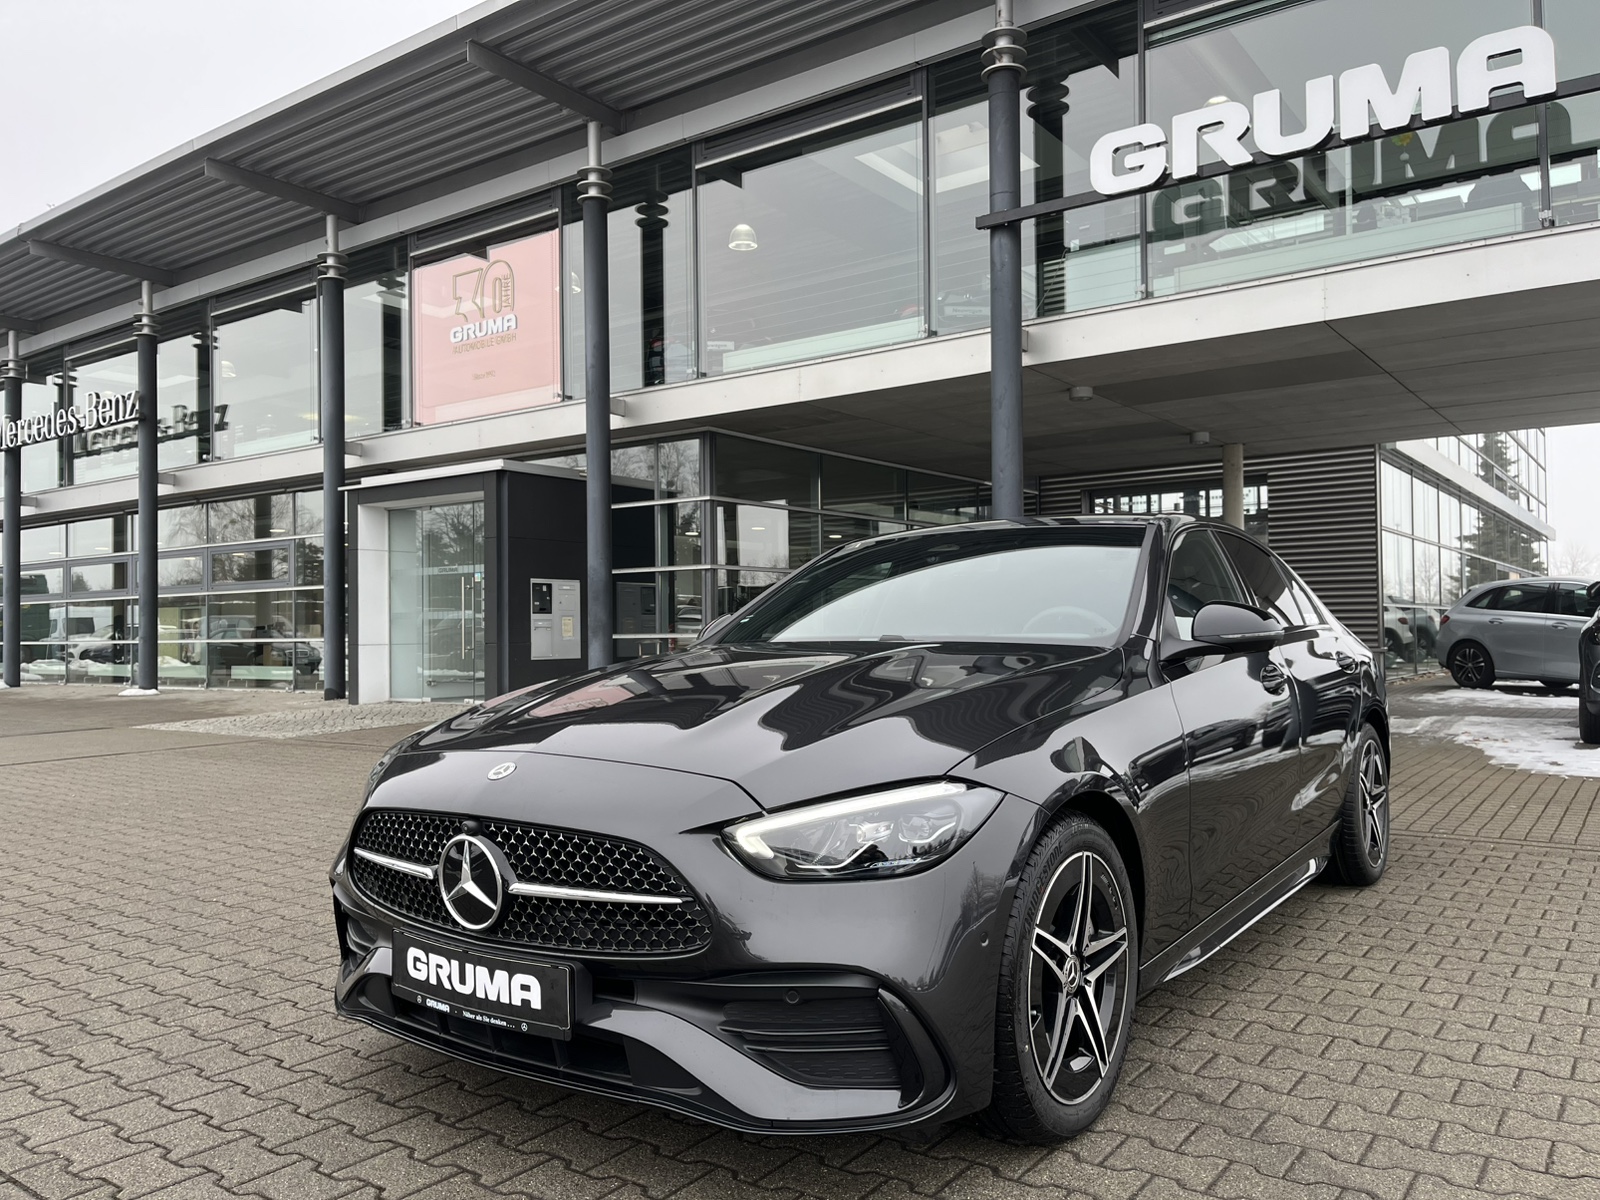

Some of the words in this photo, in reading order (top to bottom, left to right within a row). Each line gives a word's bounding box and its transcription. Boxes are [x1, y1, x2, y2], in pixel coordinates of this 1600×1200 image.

[1090, 25, 1557, 196] GRUMA
[501, 273, 511, 309] JAHRE
[450, 313, 517, 343] GRUMA
[406, 946, 542, 1010] GRUMA
[426, 998, 450, 1013] GRUMA
